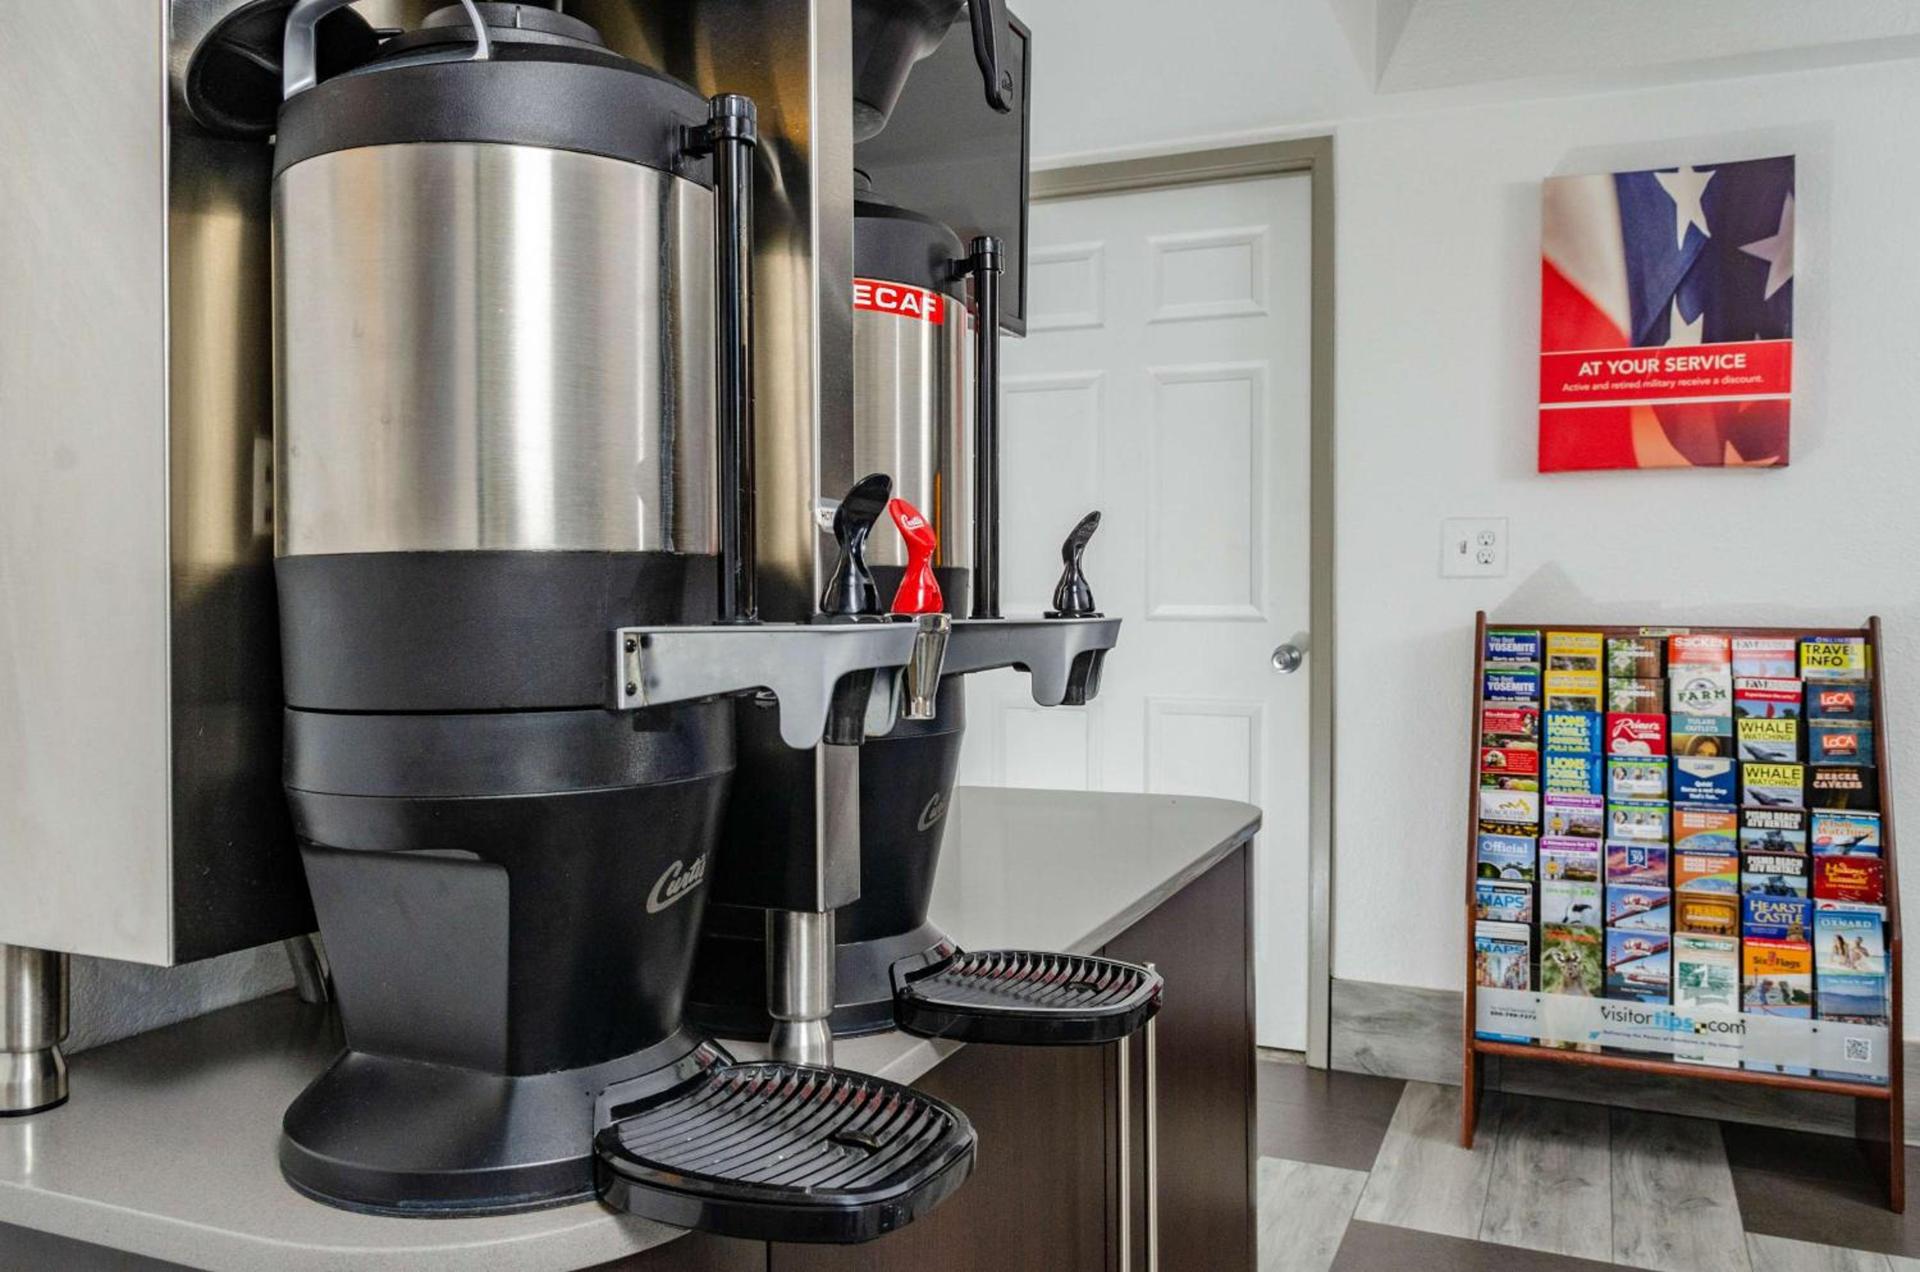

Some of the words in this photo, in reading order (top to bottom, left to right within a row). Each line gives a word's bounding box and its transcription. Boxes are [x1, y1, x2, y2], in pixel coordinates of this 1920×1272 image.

[853, 284, 937, 314] ECAF
[1578, 361, 1603, 376] AT
[1606, 358, 1659, 375] YOUR
[1664, 353, 1747, 372] SERVICE
[1562, 383, 1590, 392] Active
[1592, 381, 1610, 390] and
[1611, 380, 1641, 389] retired
[1642, 379, 1676, 389] military
[1677, 377, 1711, 386] receive
[1721, 375, 1765, 385] discount.
[1489, 643, 1536, 653] YOSEMITE
[1805, 656, 1843, 667] INFO
[1487, 682, 1536, 692] YOSEMITE
[1677, 689, 1727, 702] FARM
[1740, 722, 1793, 734] WHALE
[1743, 733, 1792, 741] WATCHING
[1746, 767, 1801, 780] WHALE
[1748, 779, 1798, 787] WATCHING
[1482, 840, 1528, 854] Official
[1479, 894, 1525, 908] MAPS
[1750, 900, 1805, 913] HEARST
[1754, 911, 1803, 924] CASTLE
[1821, 919, 1872, 929] OXNARD
[1753, 956, 1768, 965] Six
[1776, 959, 1801, 968] Flags
